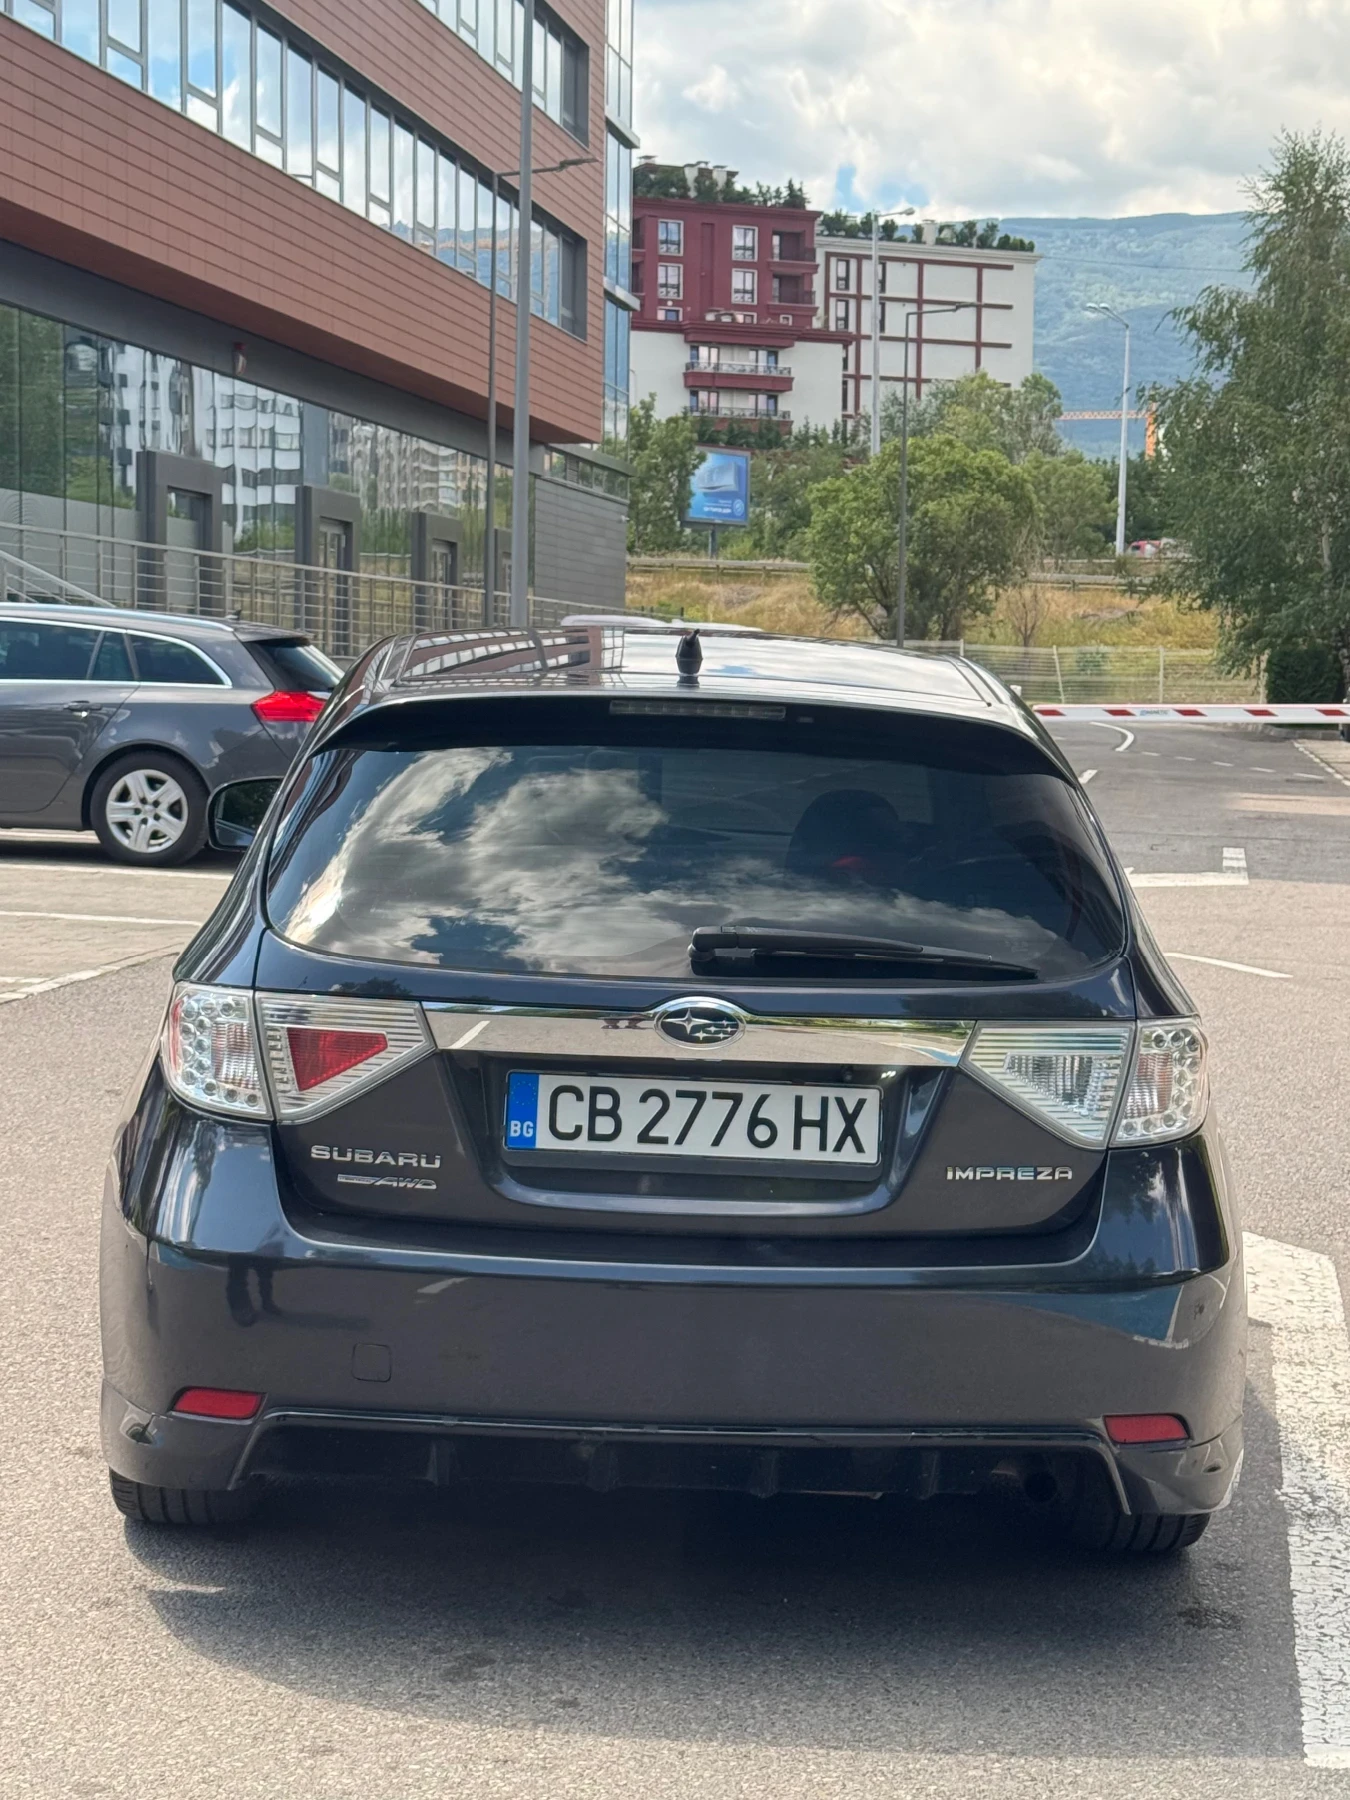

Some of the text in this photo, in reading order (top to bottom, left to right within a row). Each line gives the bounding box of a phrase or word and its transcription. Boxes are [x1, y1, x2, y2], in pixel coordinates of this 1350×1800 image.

[548, 1085, 867, 1153] CB 2776 HX
[509, 1120, 534, 1138] BG
[310, 1144, 441, 1168] SUBARU
[946, 1166, 1073, 1180] IMPREZA
[374, 1176, 437, 1189] AWD
